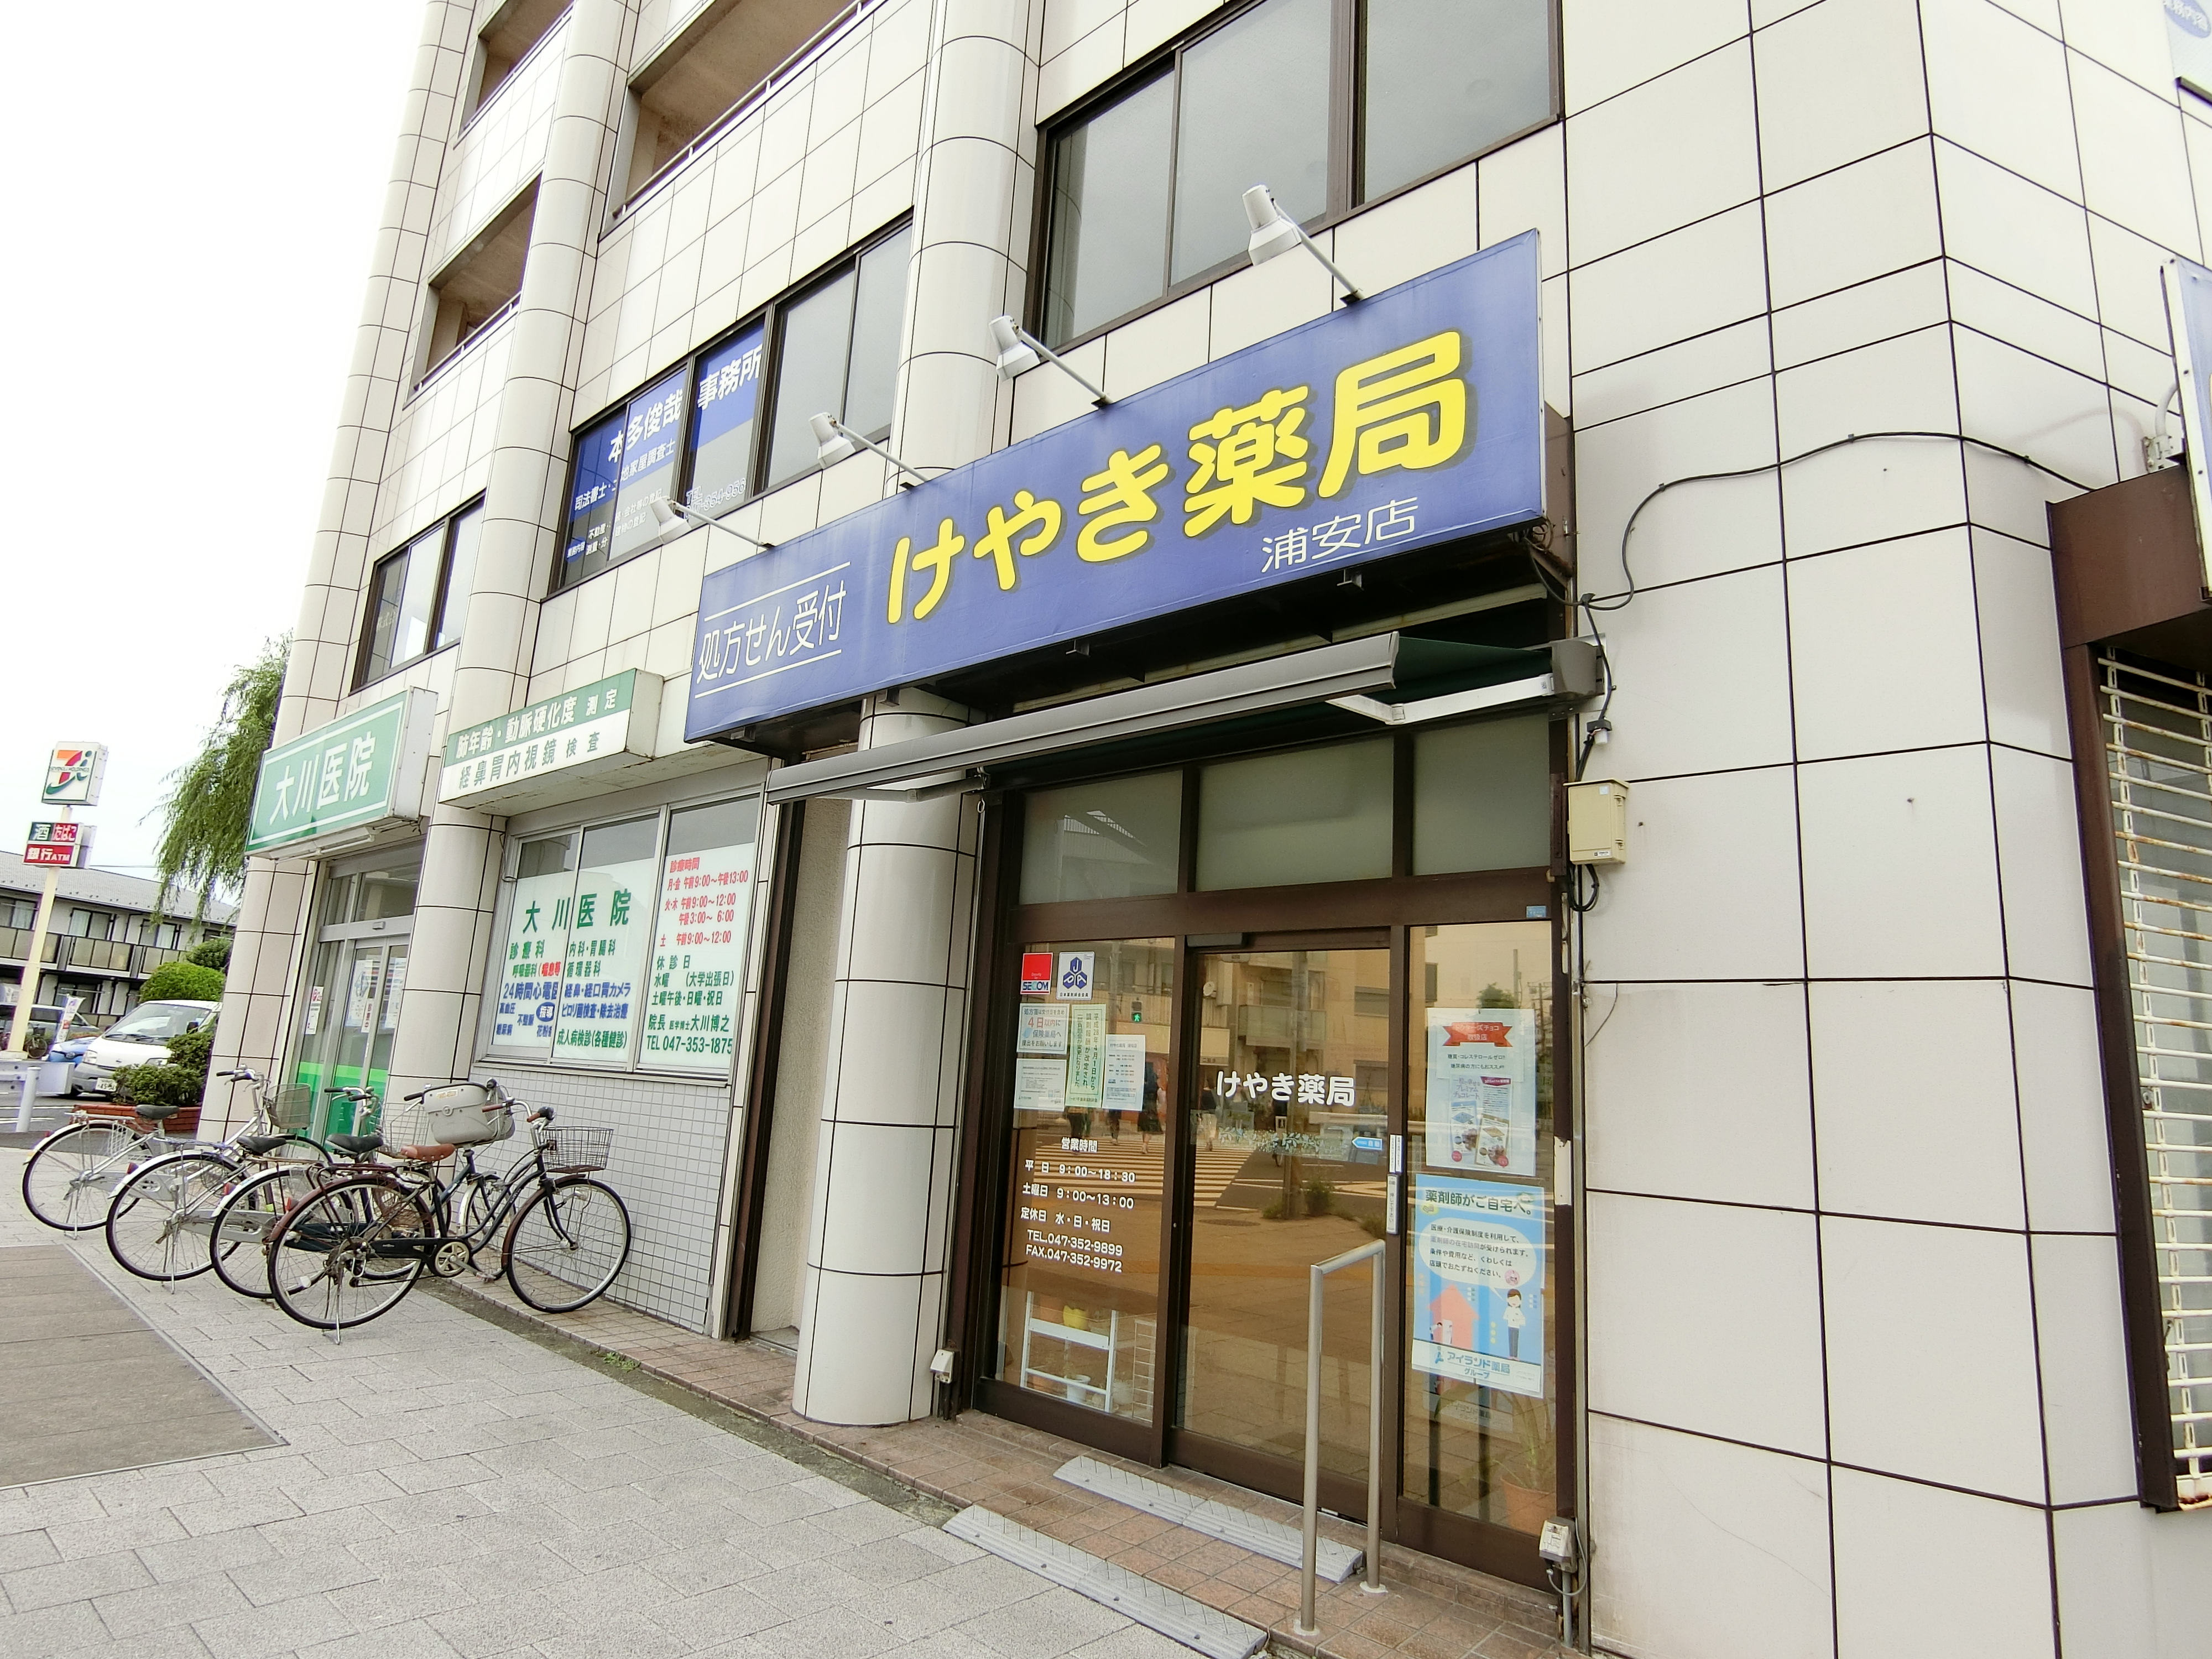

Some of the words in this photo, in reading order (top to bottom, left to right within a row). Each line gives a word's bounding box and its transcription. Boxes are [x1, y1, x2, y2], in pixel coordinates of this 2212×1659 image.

[697, 344, 763, 410] 事務所
[888, 332, 1465, 623] けやき薬局
[686, 486, 702, 504] TEL
[1261, 497, 1418, 573] 浦安店
[697, 580, 847, 684] 処方せん受付
[456, 696, 577, 759] 肺年齢・動脈硬化度
[586, 689, 618, 716] 測定
[459, 738, 557, 790] 経鼻胃内視鏡
[566, 732, 600, 758] 検査
[269, 731, 376, 825] 大川医院
[33, 824, 51, 841] 酒
[53, 825, 77, 841] たばこ
[670, 857, 700, 873] 診療時間
[667, 878, 681, 890] 月・金
[523, 889, 632, 934] 大川医院
[569, 939, 616, 957] 内科・胃腸科
[660, 934, 666, 947] 土
[509, 940, 545, 960] 診療科
[567, 961, 601, 977] 循環器科
[656, 955, 691, 970] 休診日
[654, 973, 670, 987] 水曜
[686, 971, 734, 987] (大学出張日)
[1022, 981, 1048, 990] SECOM
[564, 982, 631, 998] 経鼻・経口胃カメラ
[651, 990, 723, 1006] 土曜午後・日曜・祝日
[499, 1003, 516, 1014] 高血圧
[562, 1003, 629, 1019] ピロリ菌検査・除去治療
[648, 1014, 665, 1030] 院長
[691, 1014, 729, 1032] 大川博之
[1028, 1017, 1061, 1028] 4日以内に
[557, 1029, 627, 1048] 成人病検診(各種健診)
[647, 1035, 660, 1050] TEL
[663, 1035, 733, 1054] 047-353-1875
[1217, 1071, 1355, 1107] けやき薬局
[1061, 1137, 1098, 1152] 営業時間
[1025, 1160, 1050, 1173] 平日
[1022, 1182, 1048, 1197] 土曜日
[1426, 1190, 1531, 1215] 薬剤師がご自宅へ。
[1020, 1207, 1047, 1222] 定休日
[1055, 1212, 1110, 1233] 水・日・祝日
[1464, 1368, 1490, 1379] グループ
